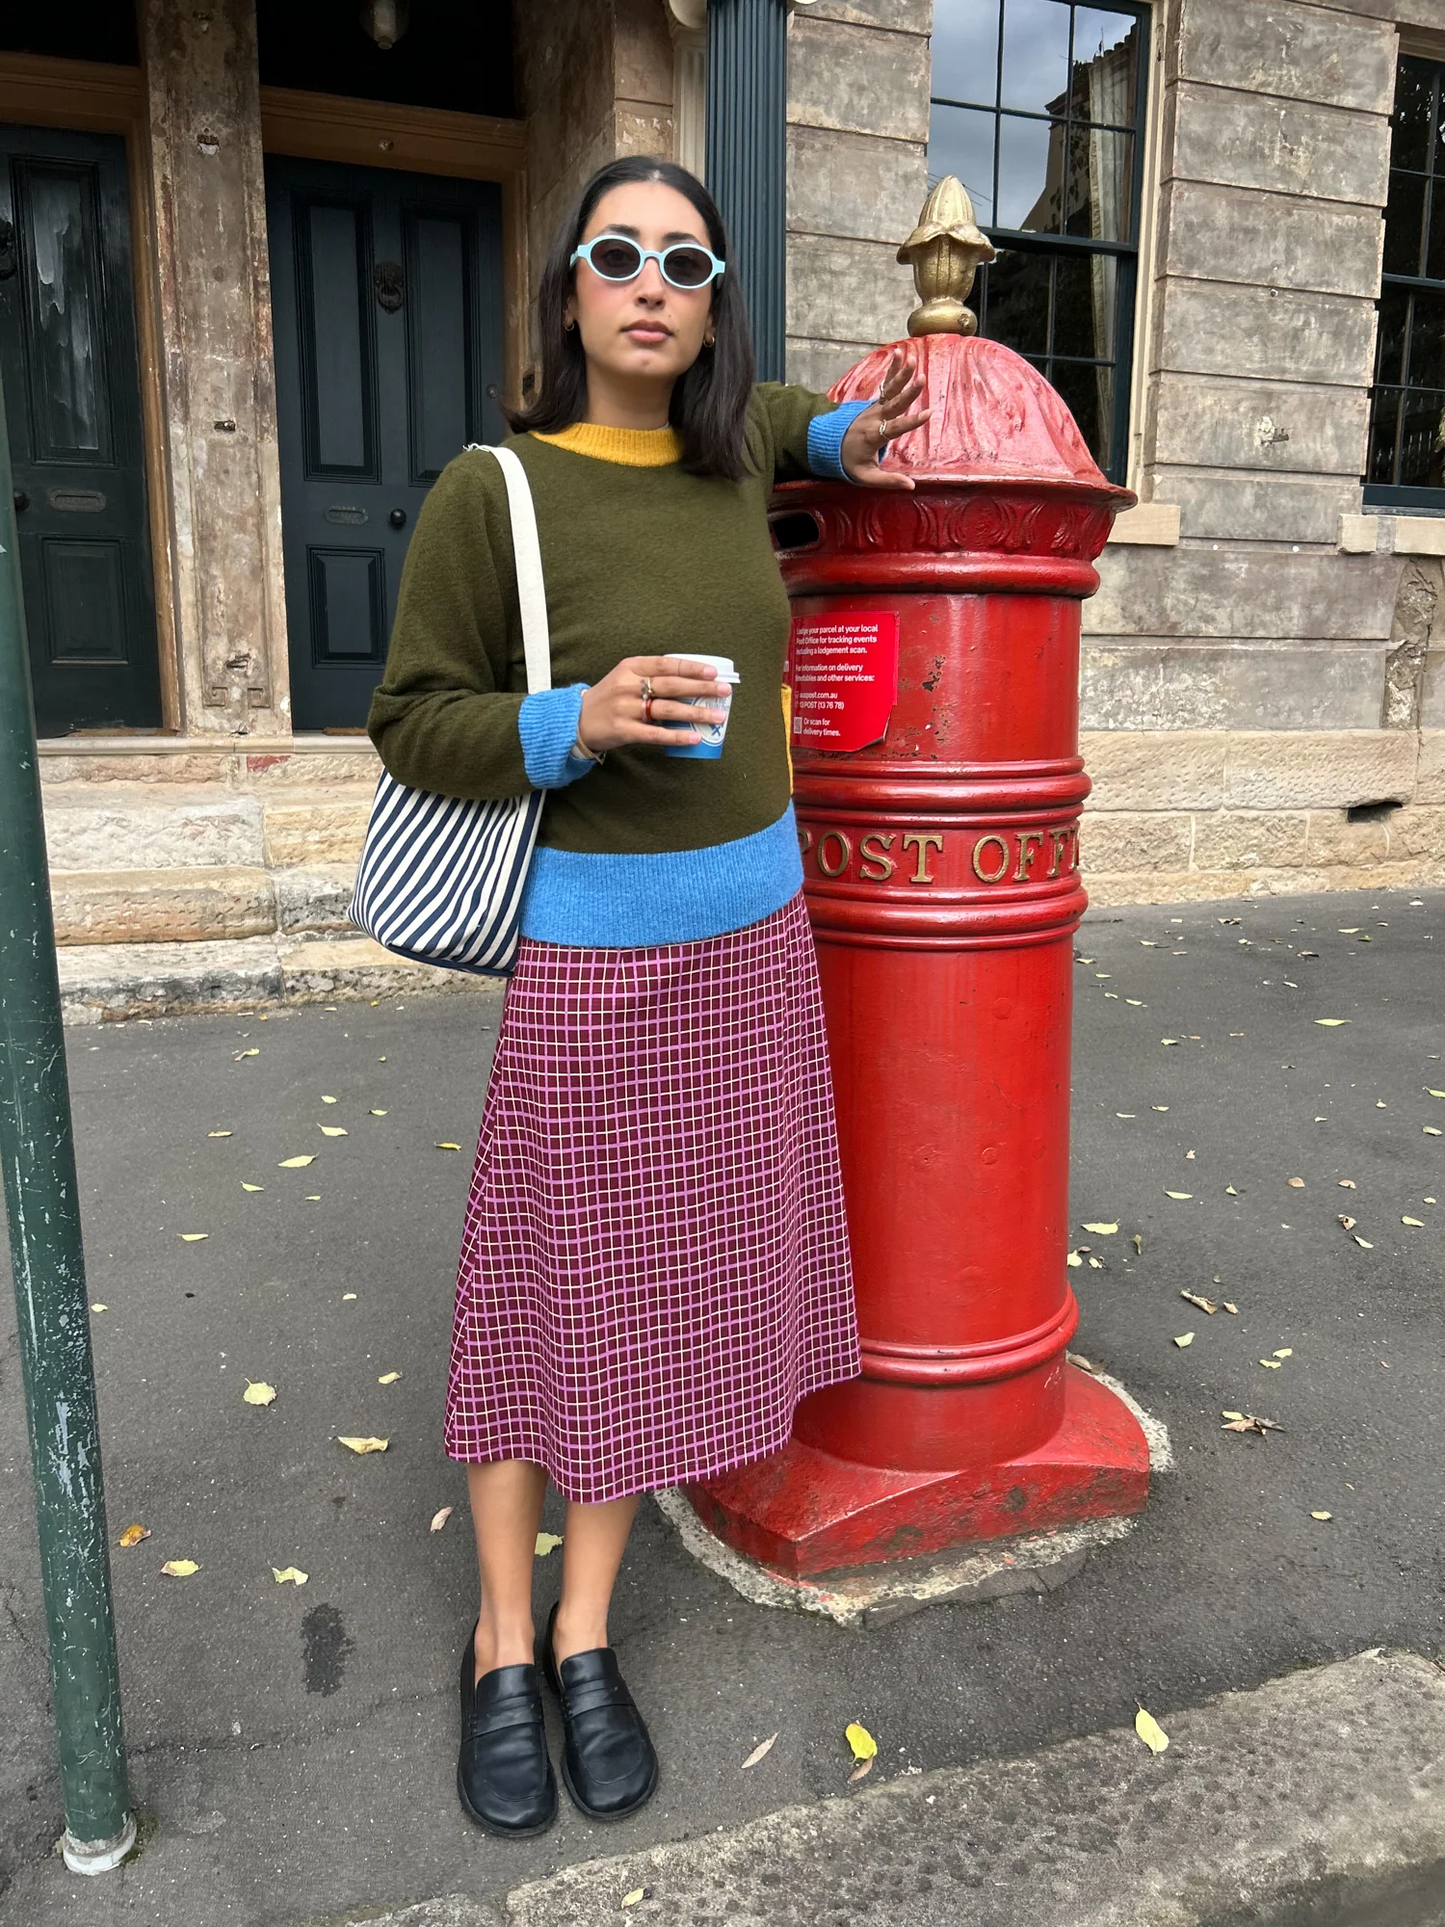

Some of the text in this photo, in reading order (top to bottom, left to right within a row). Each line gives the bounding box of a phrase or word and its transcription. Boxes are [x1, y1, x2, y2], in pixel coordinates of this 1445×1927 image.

[809, 627, 819, 635] your
[820, 625, 837, 633] parcel
[845, 626, 860, 634] your
[861, 624, 878, 632] local
[828, 636, 852, 645] tracking
[853, 635, 876, 643] events
[818, 646, 848, 655] lodgement
[850, 646, 867, 654] scan.
[837, 664, 863, 672] delivery
[845, 673, 875, 682] services:
[835, 701, 845, 710] 78)
[803, 729, 823, 737] delivery
